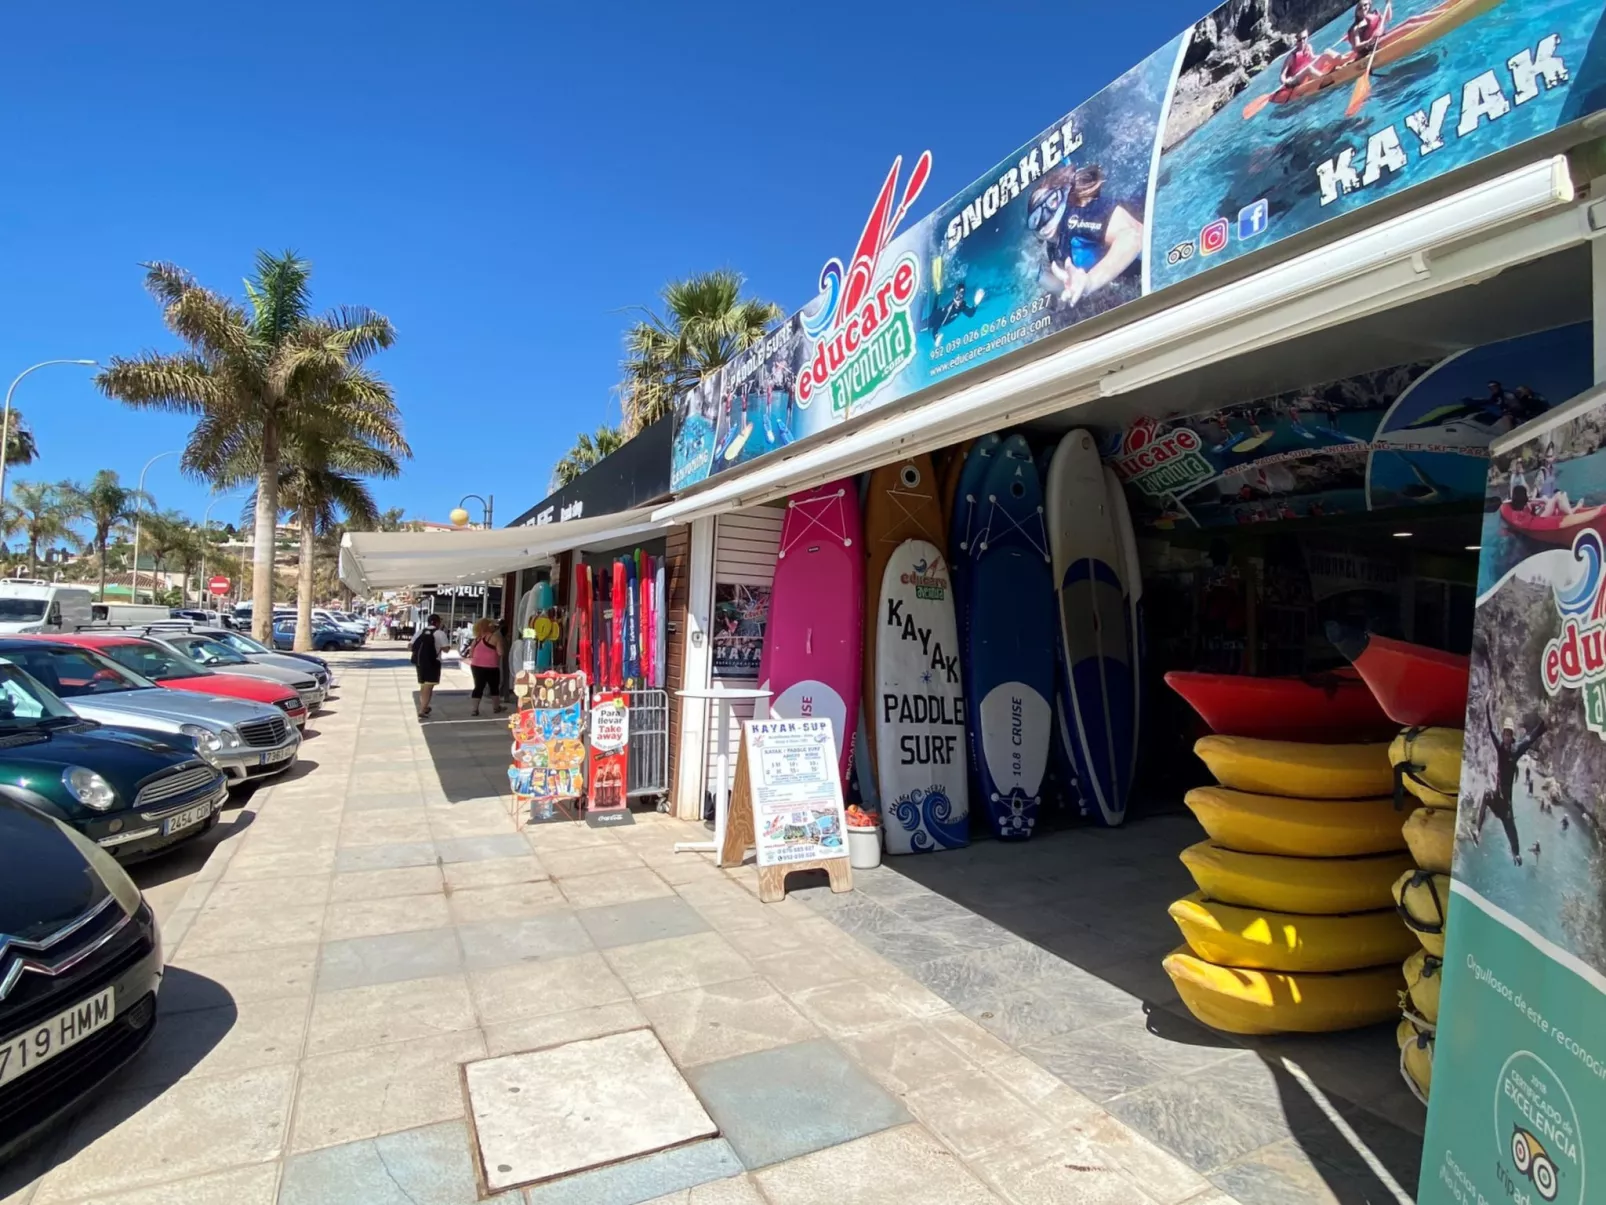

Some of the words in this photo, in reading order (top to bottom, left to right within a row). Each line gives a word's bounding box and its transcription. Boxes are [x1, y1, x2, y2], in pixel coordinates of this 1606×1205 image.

[1317, 33, 1569, 207] KAYAK
[947, 119, 1083, 250] SNORKEL
[799, 263, 913, 401] educare
[989, 318, 1007, 334] 676
[1010, 308, 1028, 324] 685
[1031, 293, 1052, 313] 827
[730, 347, 765, 391] PADDLE
[765, 320, 794, 359] SURF
[835, 319, 906, 408] aventura
[929, 315, 1051, 376] www.educare-aventura.com
[930, 346, 945, 360] 952
[945, 337, 961, 353] 039
[963, 331, 979, 346] 026
[1324, 442, 1391, 454] SNORKELING
[1404, 443, 1422, 451] JET
[1142, 456, 1205, 491] aventura
[900, 571, 947, 590] educare
[916, 585, 944, 600] aventura
[715, 646, 761, 660] KAYA
[887, 598, 959, 684] KAYAK
[1546, 622, 1606, 685] edu
[597, 717, 623, 725] llevar
[600, 710, 621, 718] Para
[801, 695, 813, 717] ISE
[883, 694, 965, 726] PADDLE
[1010, 696, 1022, 747] CRUISE
[596, 733, 623, 742] away
[598, 725, 622, 733] Take
[900, 734, 957, 765] SURF
[1012, 751, 1022, 778] 10.8
[170, 812, 193, 831] 2454
[1466, 953, 1513, 1001] Orgullosos
[1514, 993, 1527, 1014] de
[1526, 1006, 1549, 1033] este
[60, 993, 109, 1046] HMM
[1504, 1078, 1577, 1165] EXCELENCIA
[1511, 1069, 1562, 1125] CERTIFICADO
[1562, 1120, 1573, 1137] de
[1445, 1149, 1477, 1198] Gracias
